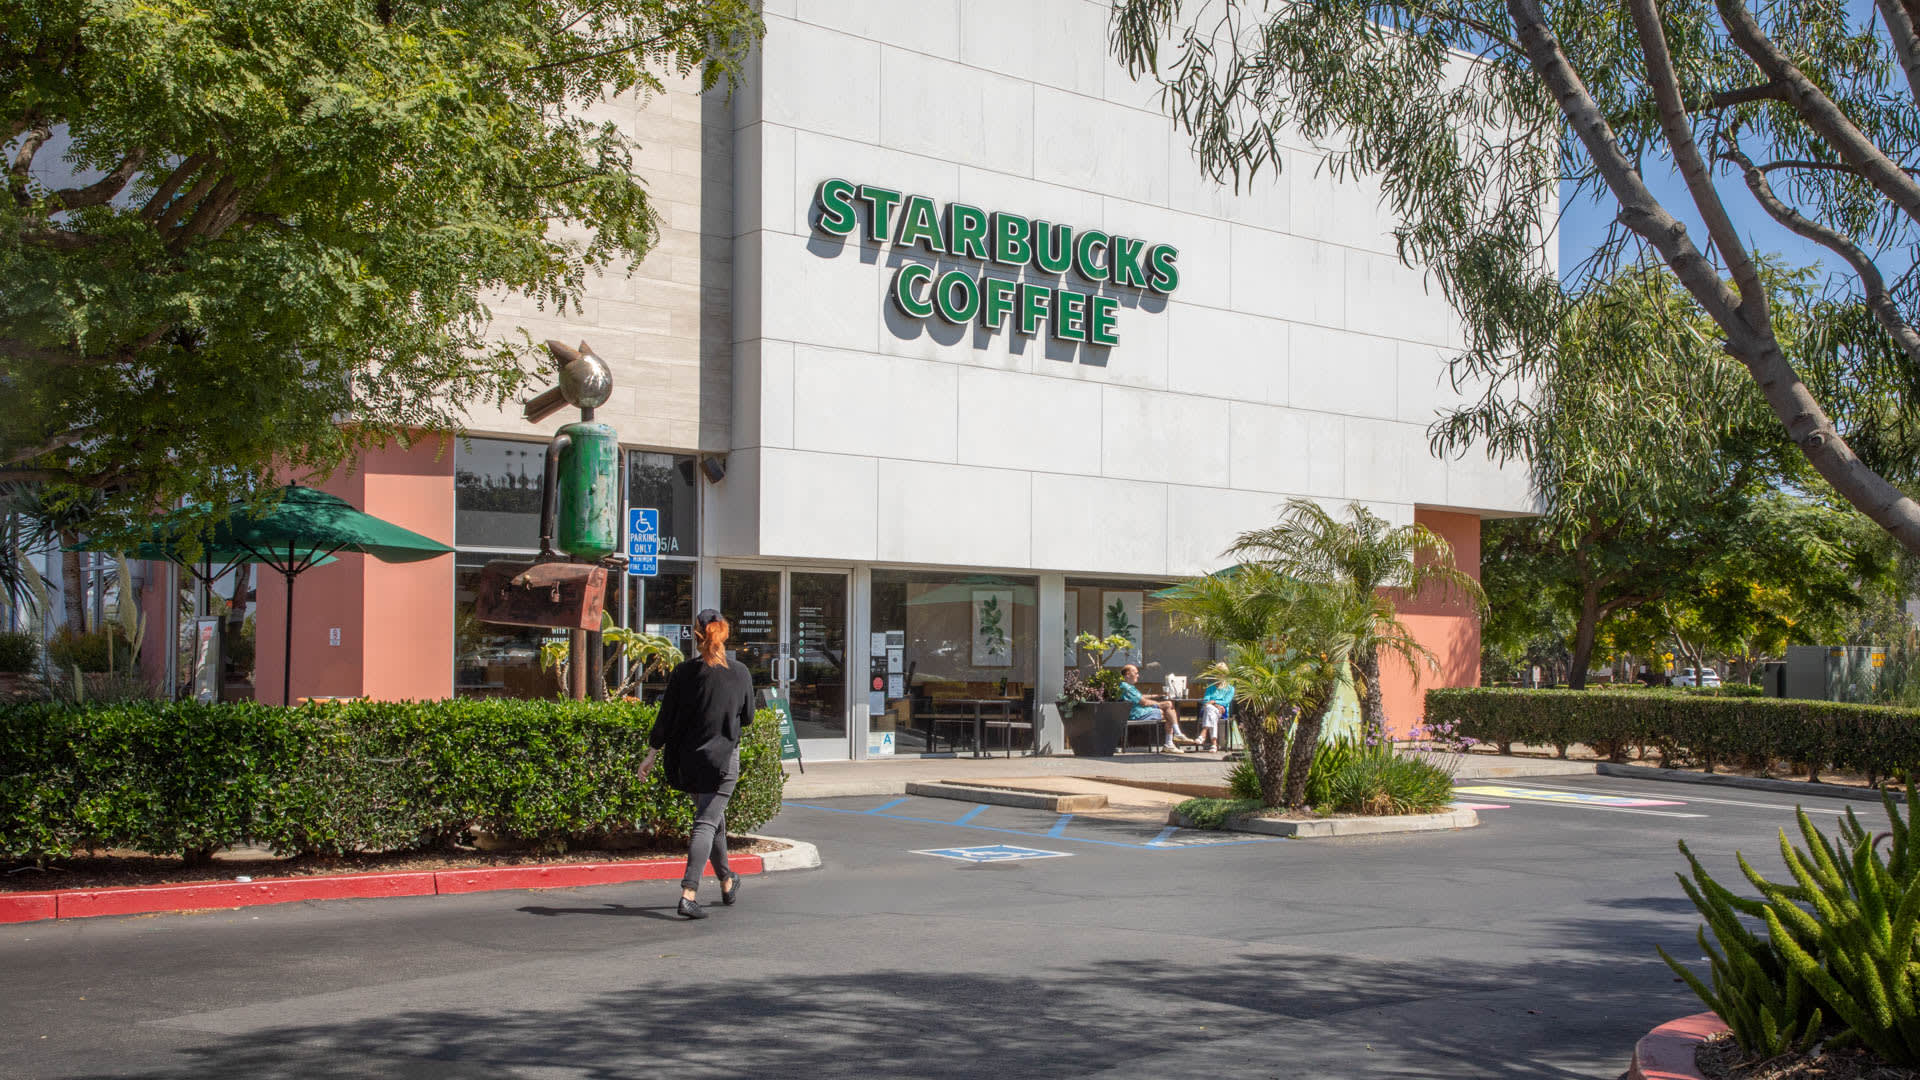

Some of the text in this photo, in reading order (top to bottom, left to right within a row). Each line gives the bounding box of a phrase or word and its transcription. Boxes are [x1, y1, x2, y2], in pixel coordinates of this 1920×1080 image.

[816, 178, 1179, 294] STARBUCKS
[893, 263, 1120, 347] COFFEE
[630, 533, 657, 543] PARKING
[634, 543, 652, 553] ONLY
[883, 733, 893, 744] A
